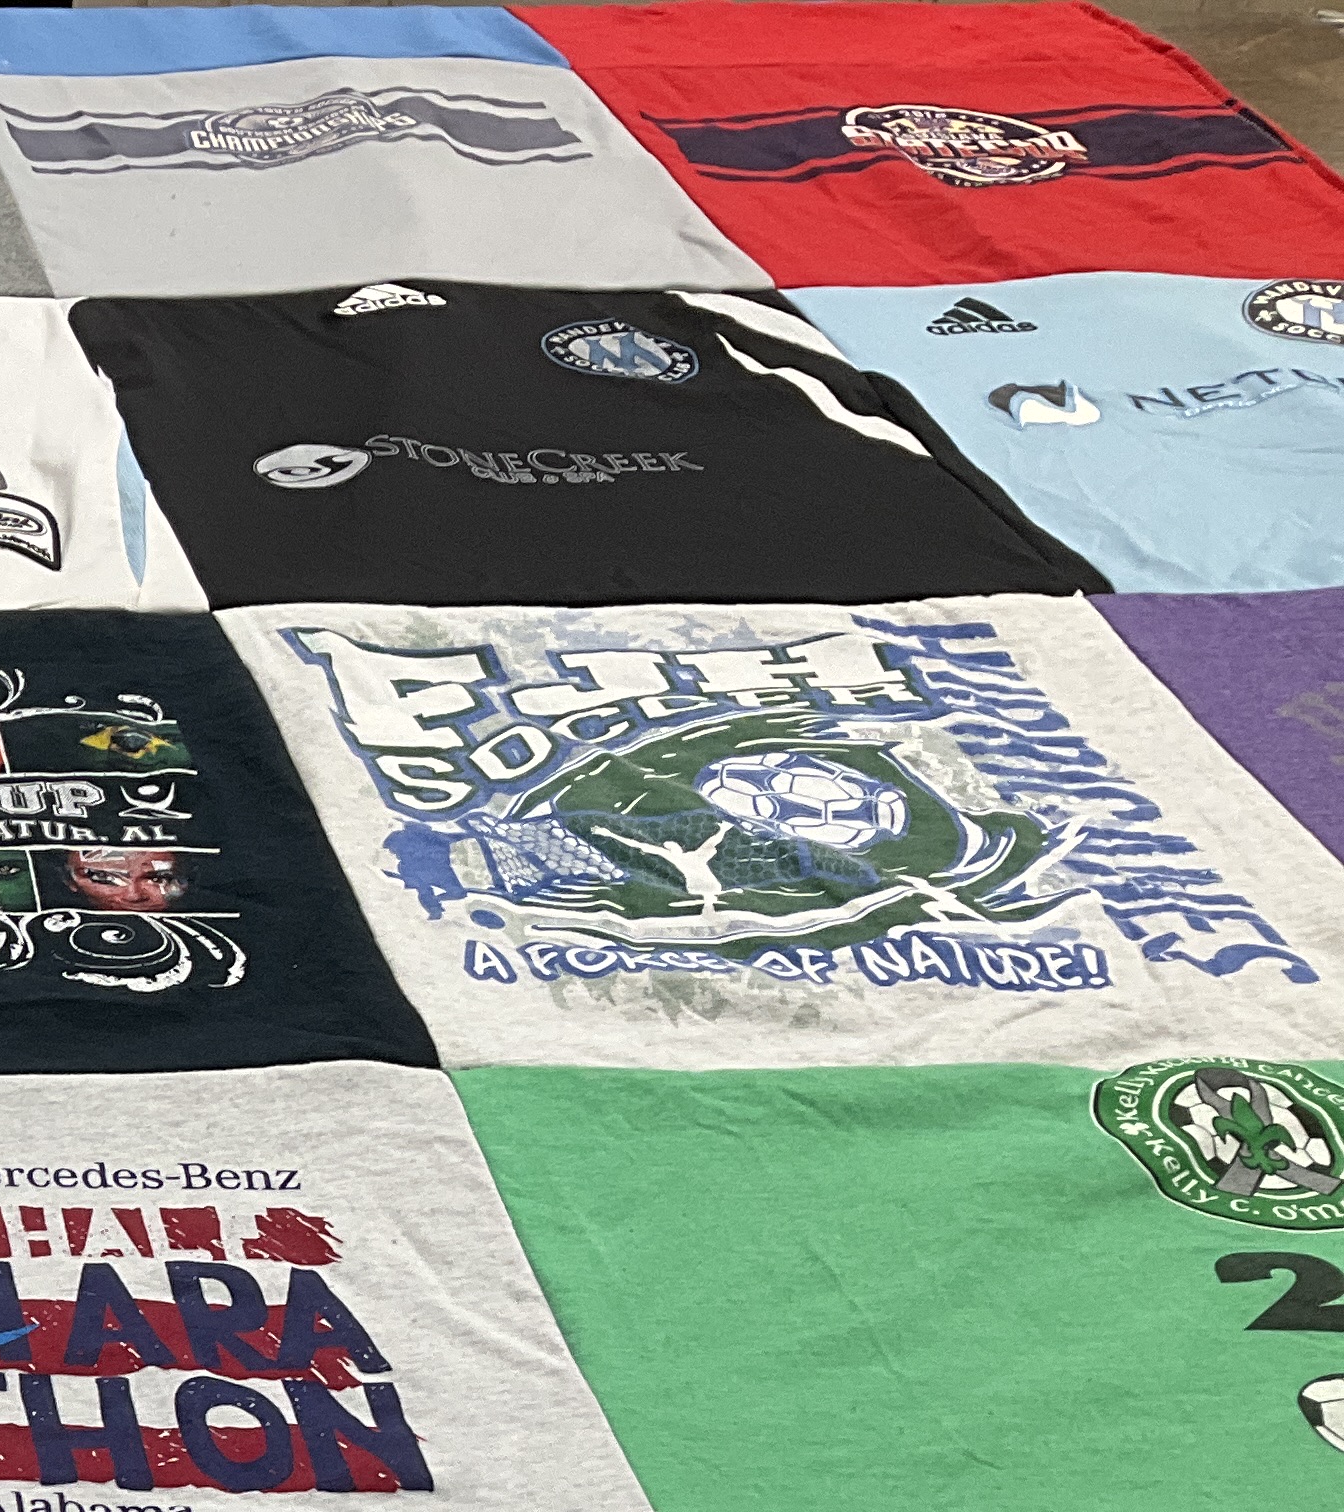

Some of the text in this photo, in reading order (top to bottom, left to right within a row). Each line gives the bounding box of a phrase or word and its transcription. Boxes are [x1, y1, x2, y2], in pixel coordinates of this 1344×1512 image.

[334, 294, 446, 315] adidas
[926, 320, 1038, 336] adidas
[122, 824, 178, 842] AL
[860, 937, 1104, 989] NATURE!
[1146, 1137, 1219, 1204] Kelly
